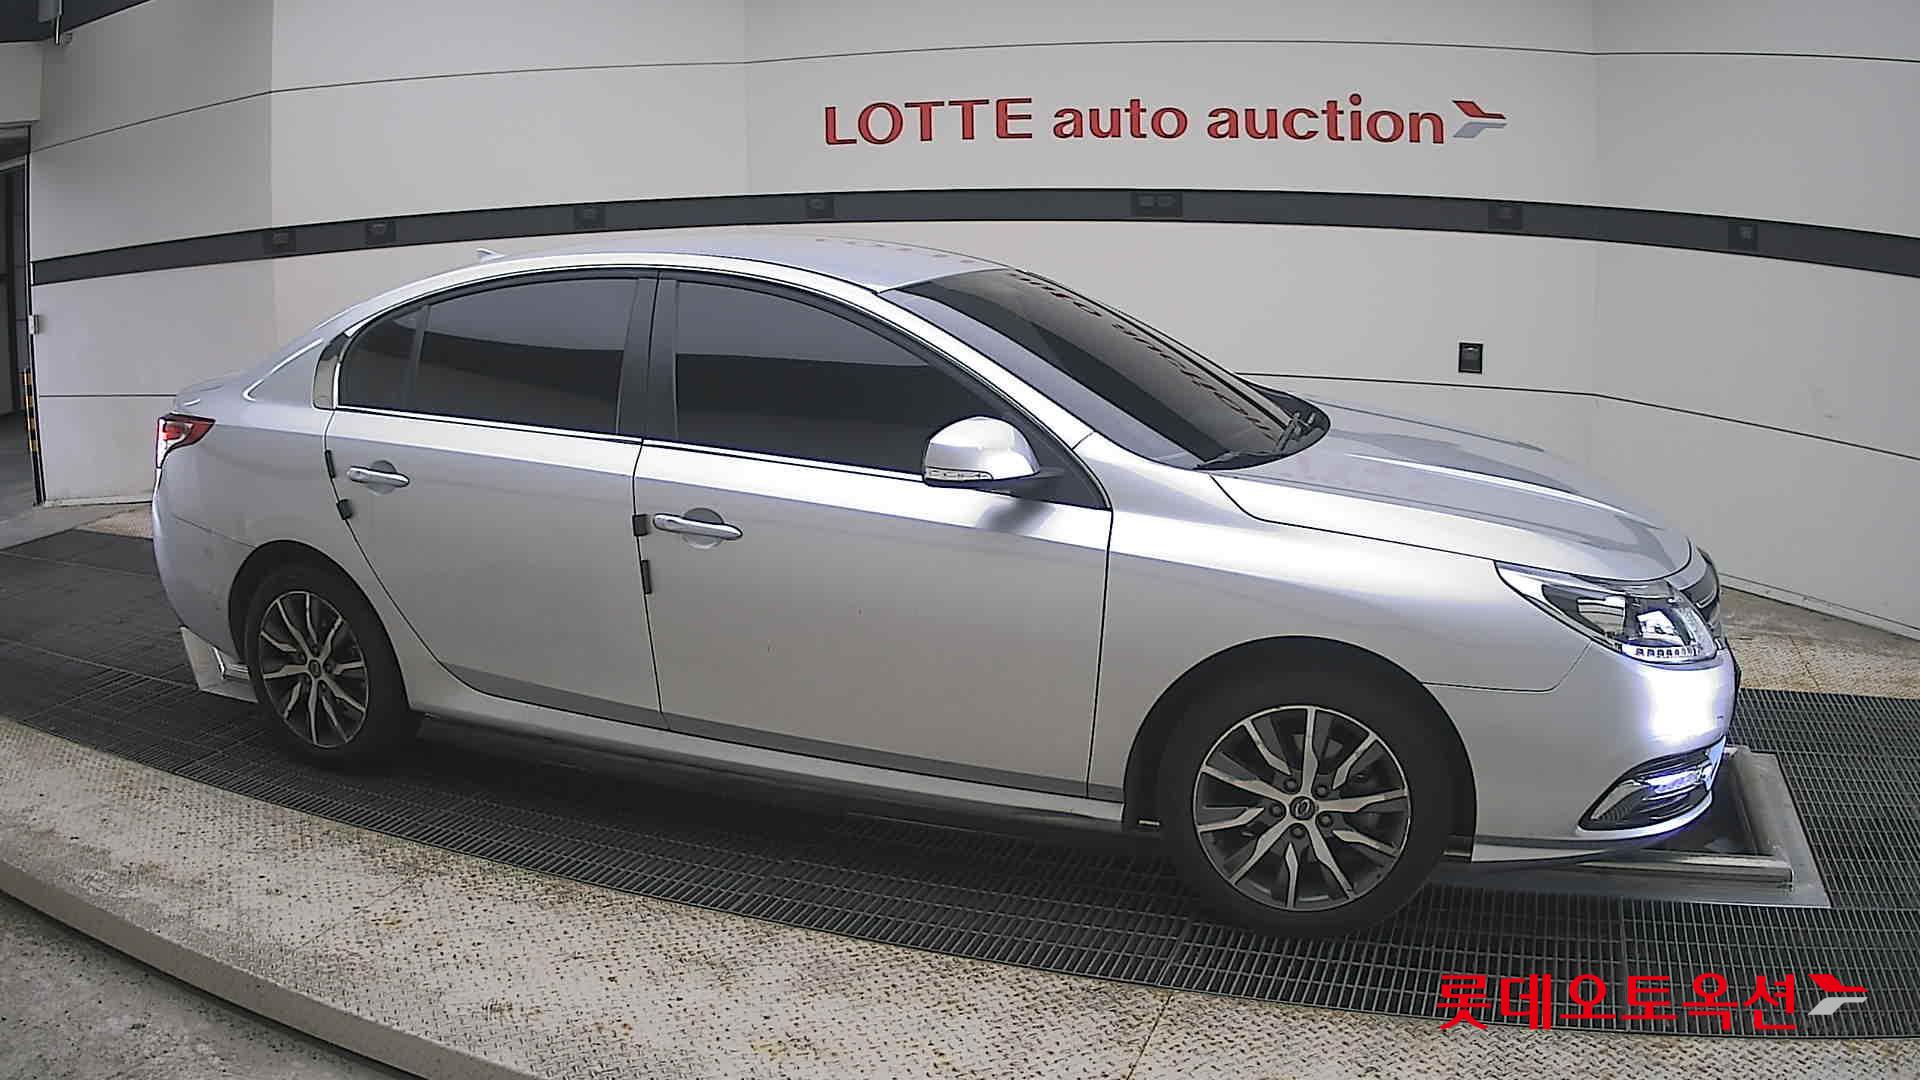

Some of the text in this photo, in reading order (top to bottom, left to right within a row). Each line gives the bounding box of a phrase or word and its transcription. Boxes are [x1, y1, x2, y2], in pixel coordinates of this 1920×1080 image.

[824, 93, 1446, 146] LOTTE auto auction
